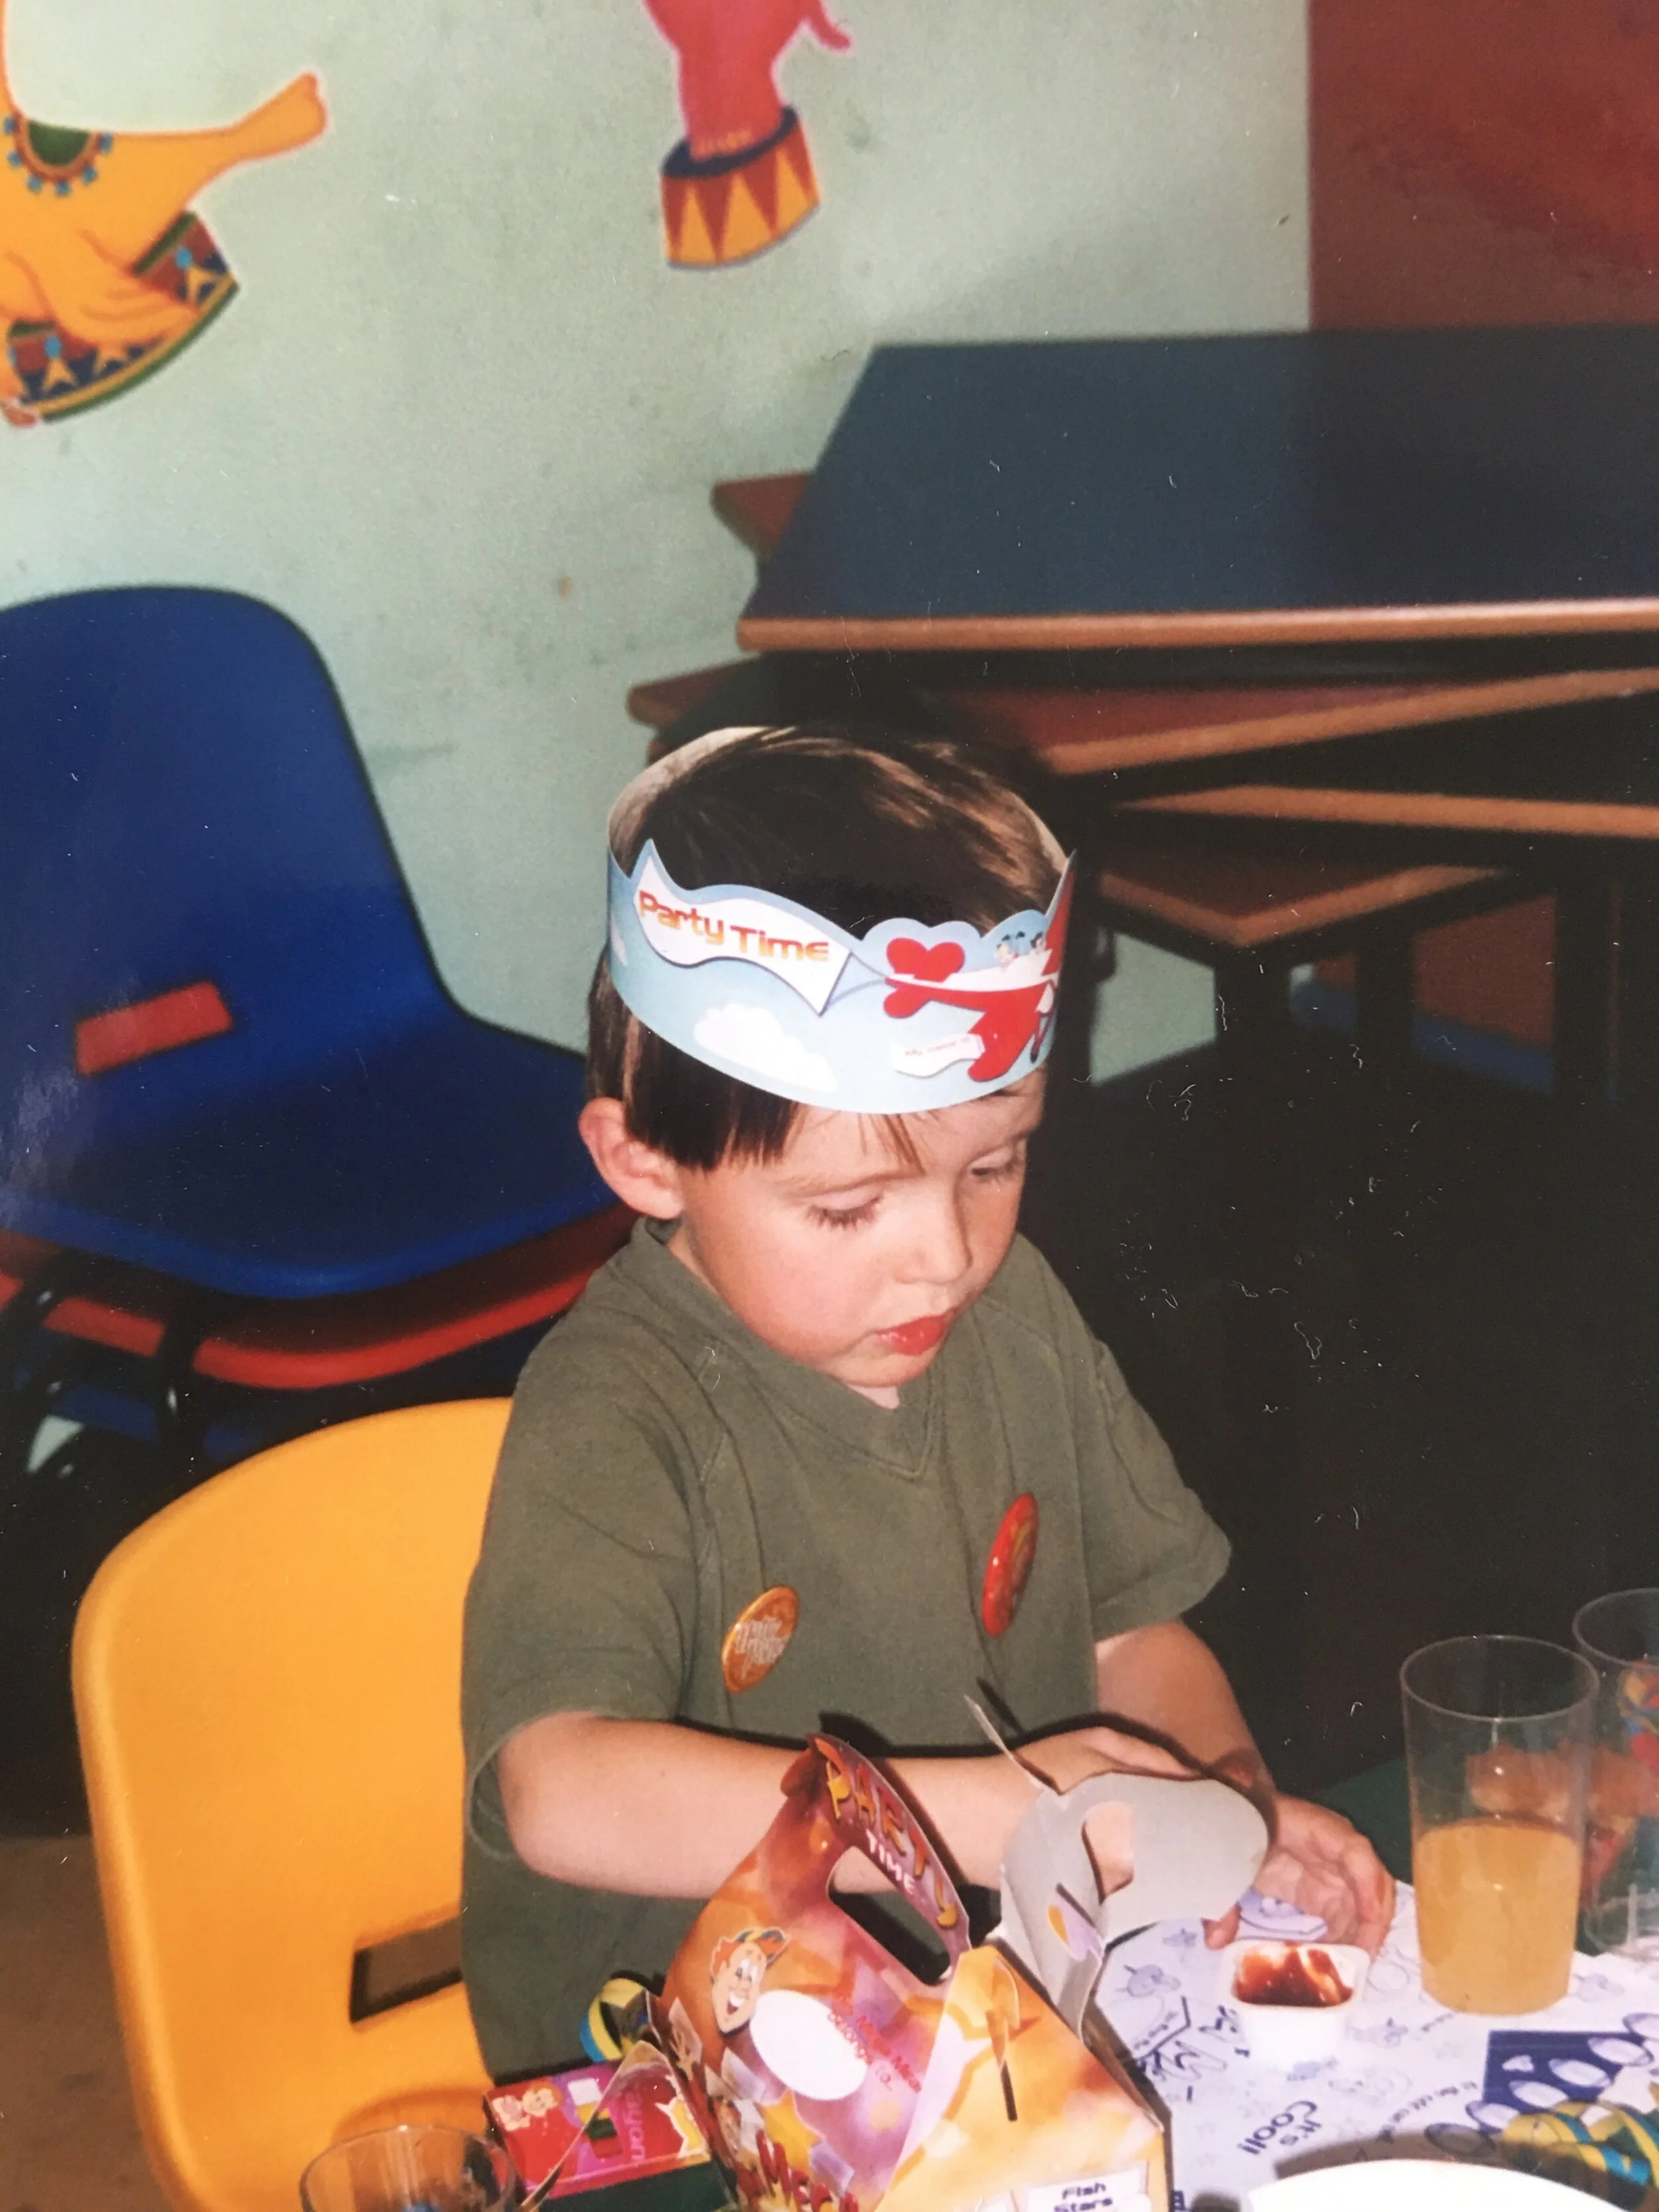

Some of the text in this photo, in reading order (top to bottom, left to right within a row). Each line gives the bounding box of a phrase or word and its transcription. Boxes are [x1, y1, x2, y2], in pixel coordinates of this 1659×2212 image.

[638, 889, 830, 962] Party Time
[865, 1828, 916, 1895] TIME
